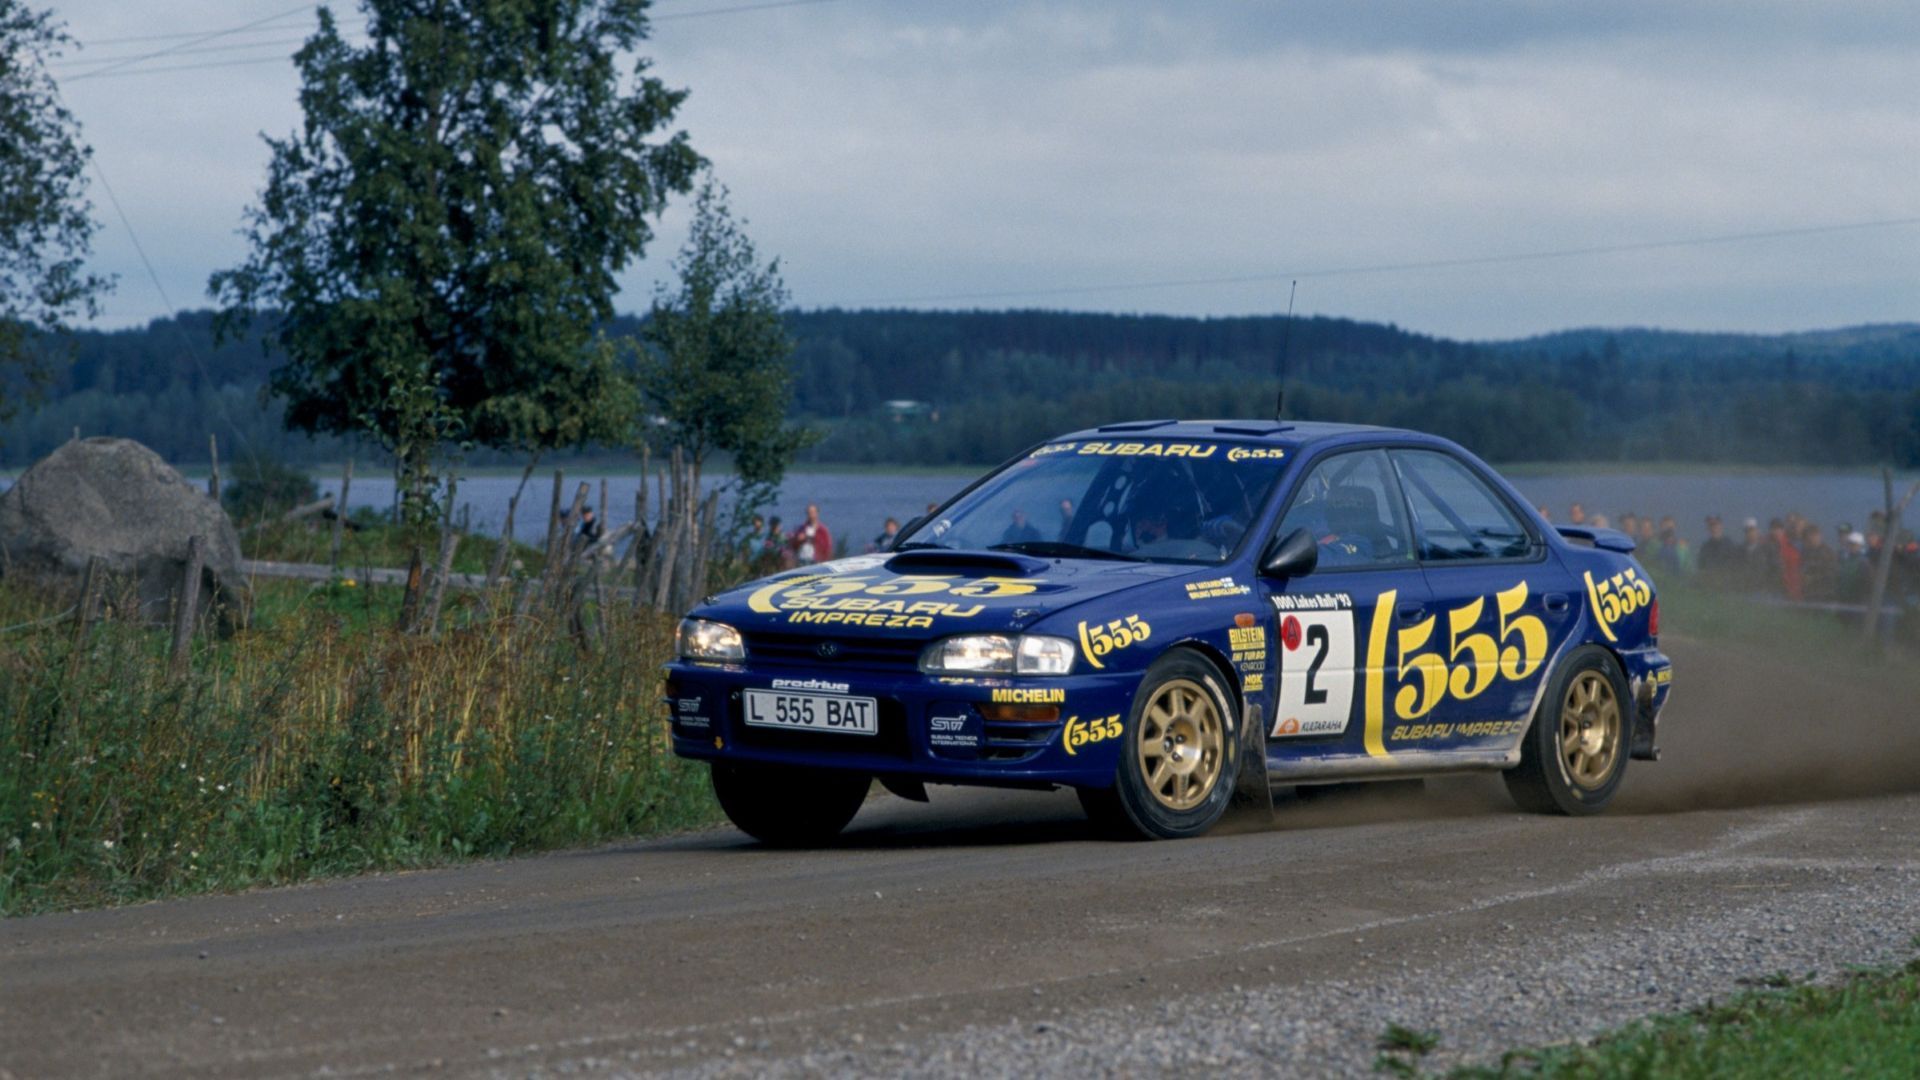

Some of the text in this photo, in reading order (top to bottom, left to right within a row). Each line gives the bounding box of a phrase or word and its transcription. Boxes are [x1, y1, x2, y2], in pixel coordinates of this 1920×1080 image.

[1078, 442, 1217, 458] SUBARU
[779, 596, 986, 617] SUBARU
[1271, 595, 1295, 609] 1000
[1292, 594, 1318, 608] Lakes
[788, 611, 934, 628] IMPREZA
[1229, 626, 1265, 643] BILSTEIN
[1244, 651, 1265, 660] TURBO
[1304, 624, 1330, 705] 2
[992, 689, 1065, 702] MICHELIN
[750, 694, 870, 728] L 555 BAT
